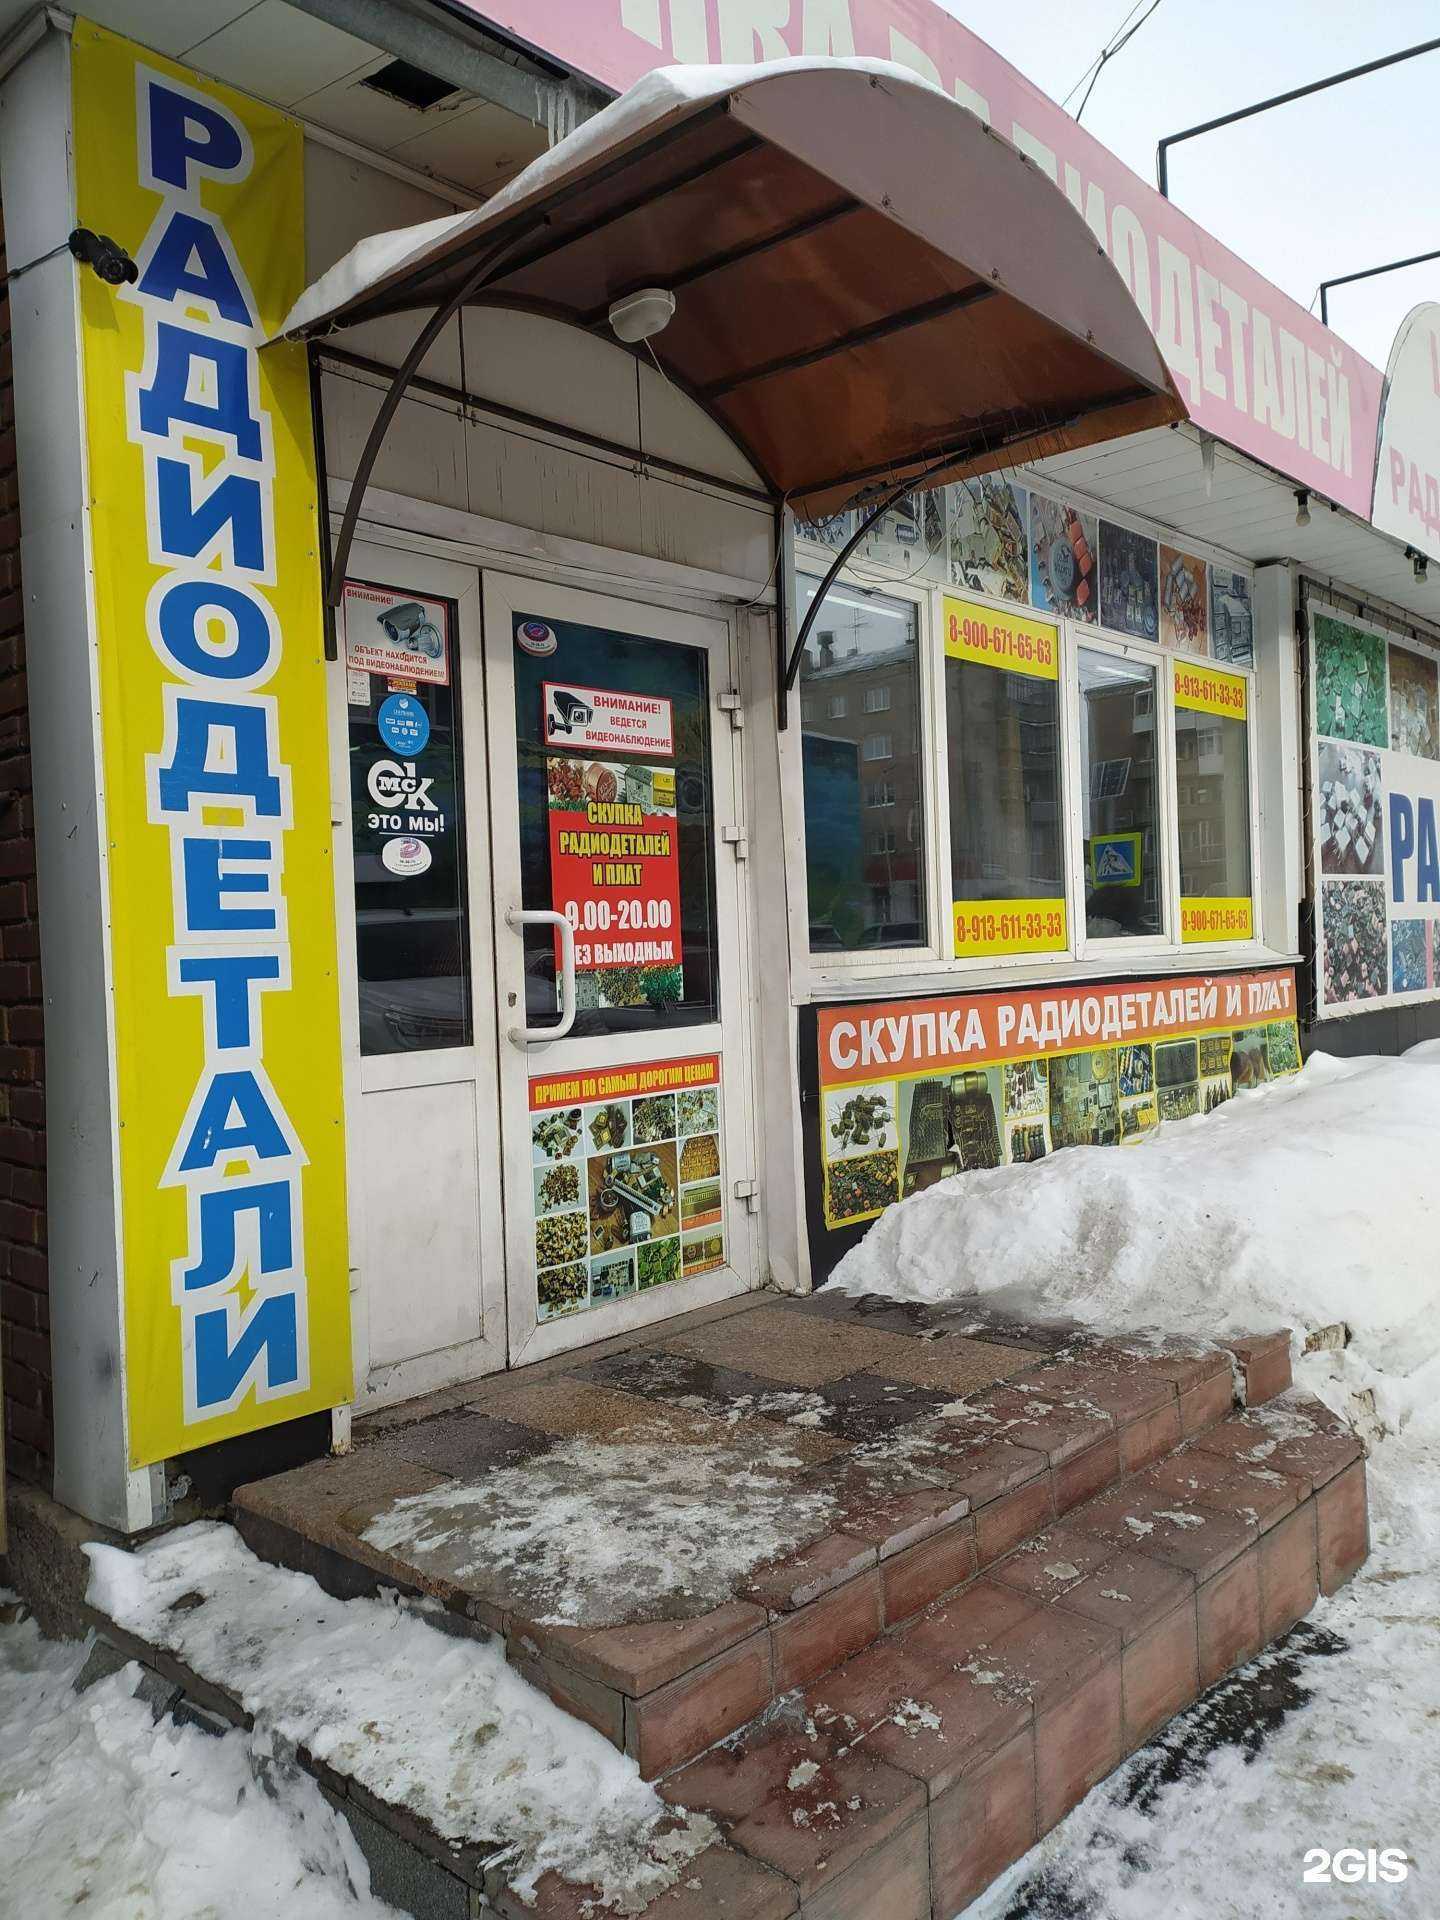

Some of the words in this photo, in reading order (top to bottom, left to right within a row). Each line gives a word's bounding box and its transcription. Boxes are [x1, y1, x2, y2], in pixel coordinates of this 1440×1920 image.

[949, 614, 1053, 666] 8-900-671-65-63
[348, 655, 365, 667] ПОД
[354, 644, 384, 658] ОБЪЕКТ
[385, 650, 428, 665] НАХОДИТСЯ
[1174, 672, 1244, 709] 8-913-611-33-33
[593, 695, 661, 715] ВНИМАНИЕ!
[610, 716, 647, 730] ВЕДЕТСЯ
[138, 80, 298, 1410] РАДИОДЕТАЛИ
[585, 730, 671, 748] ВИДЕОНАБЛЮДЕНИЕ
[588, 802, 643, 826] СКУПКА
[558, 831, 671, 858] РАДИОДЕТАЛЕЙ
[592, 863, 603, 886] И
[605, 863, 643, 886] ПЛАТ
[956, 911, 1062, 943] 8-913-611-33-33
[1182, 909, 1248, 931] 8-900-671-65-63
[574, 944, 592, 966] ЕЗ
[594, 941, 674, 965] ВЫХОДНЫХ
[829, 1008, 987, 1070] СКУПКА
[998, 978, 1218, 1049] РАДИОДЕТАЛЕЙ
[1226, 984, 1242, 1018] И
[1248, 978, 1291, 1016] ПЛАТ
[535, 1080, 580, 1104] ПРИМЕМ
[582, 1079, 597, 1097] ПО
[598, 1072, 637, 1095] САМЫМ
[639, 1065, 683, 1092] ДОРОГИМ
[684, 1062, 714, 1085] ЦЕНАМ
